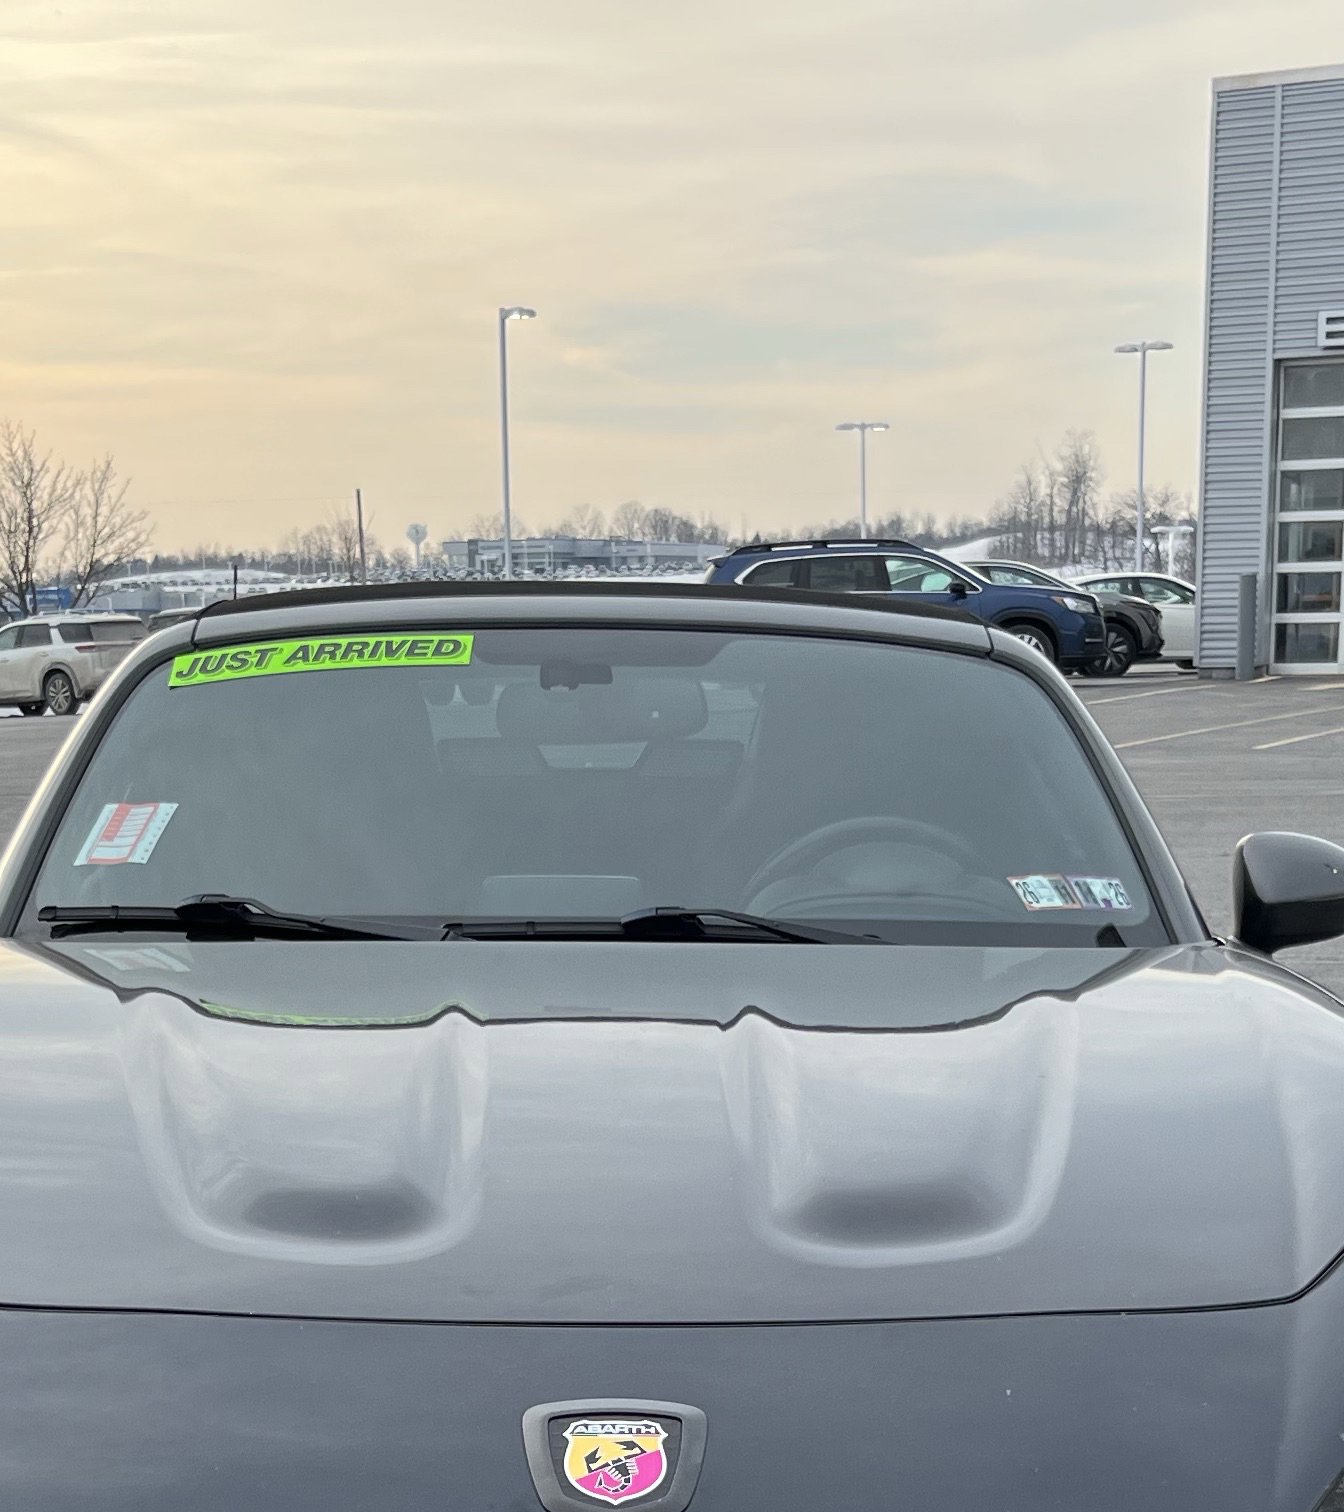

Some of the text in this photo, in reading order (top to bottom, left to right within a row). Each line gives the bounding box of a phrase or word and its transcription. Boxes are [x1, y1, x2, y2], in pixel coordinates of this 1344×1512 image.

[175, 638, 465, 680] JUST ARRIVED
[1015, 881, 1040, 905] 26
[573, 1423, 656, 1434] ABARTH
